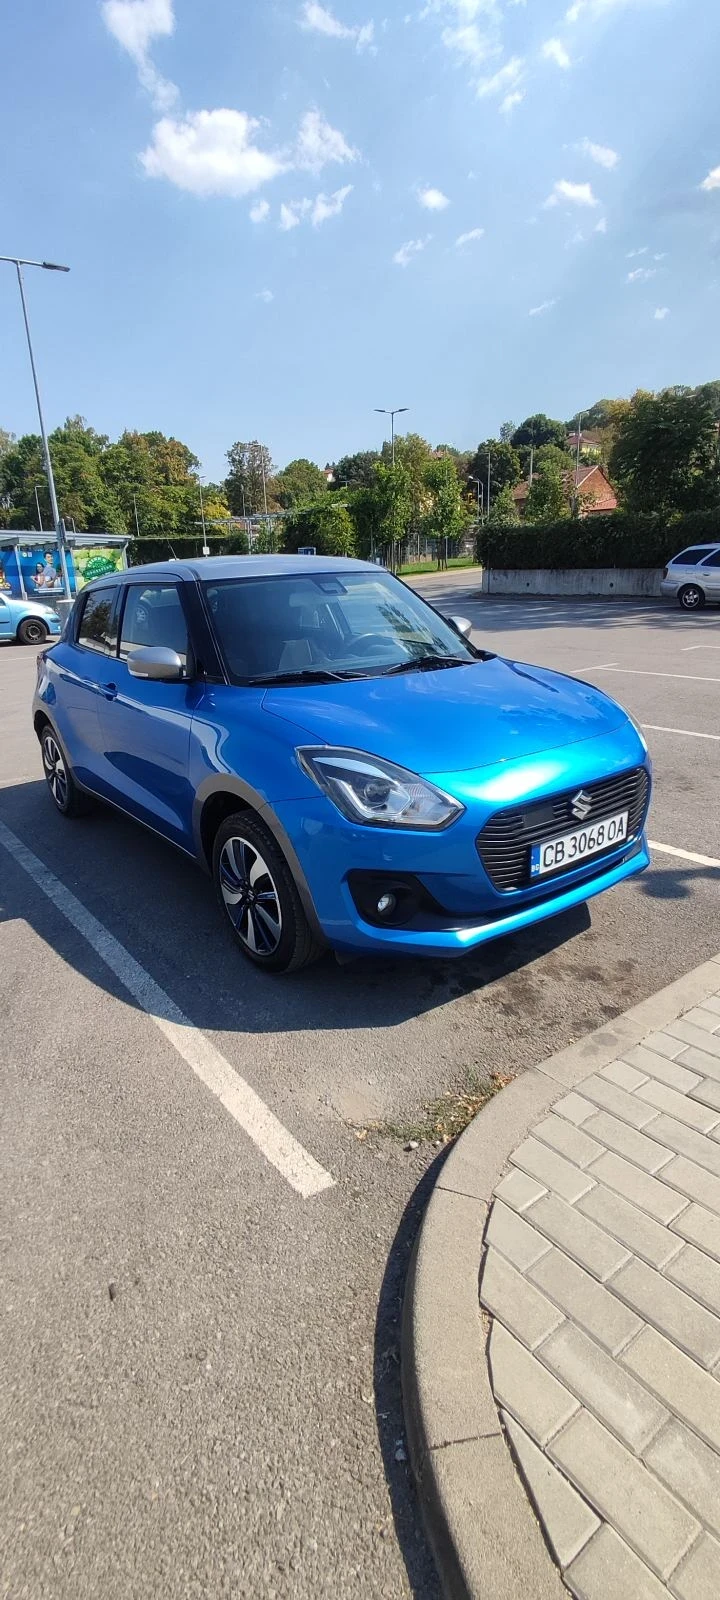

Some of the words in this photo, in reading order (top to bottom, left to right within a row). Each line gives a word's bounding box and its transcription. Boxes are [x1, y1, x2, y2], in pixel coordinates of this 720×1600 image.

[543, 841, 565, 868] CB
[568, 825, 605, 858] 3068
[607, 816, 624, 841] OA
[531, 863, 540, 873] BG
